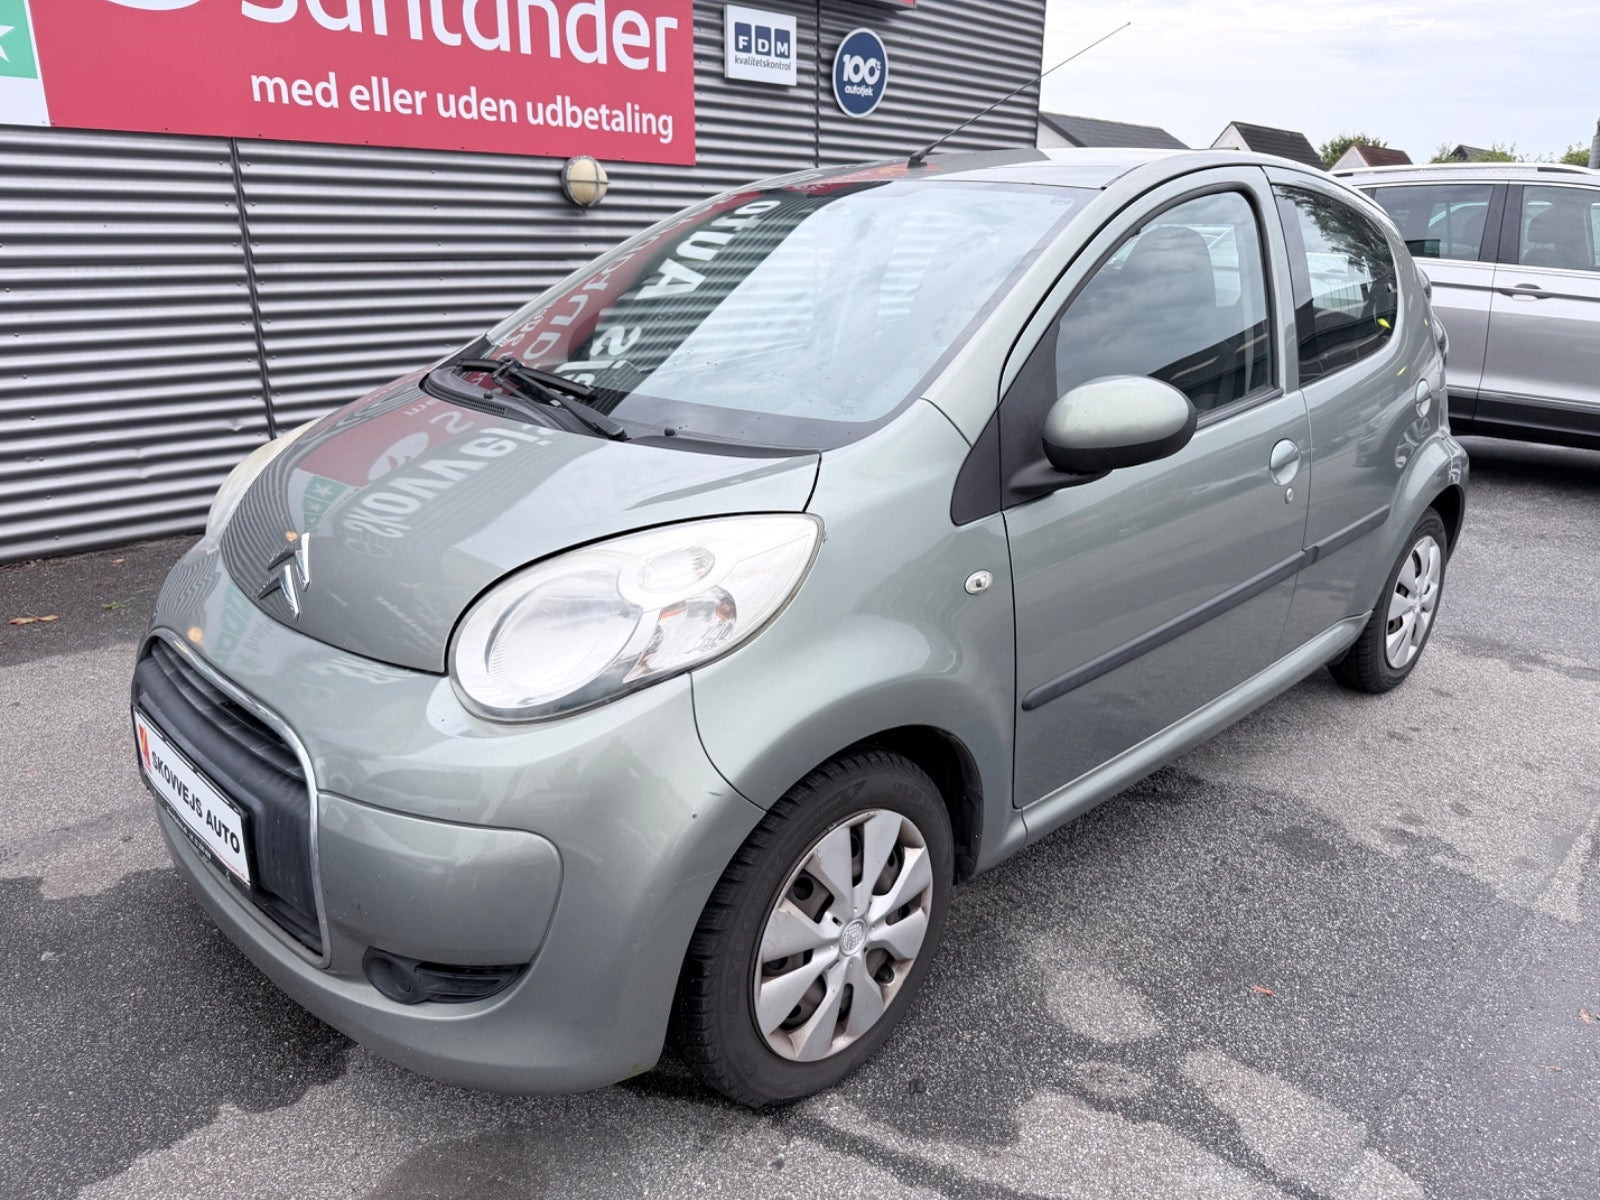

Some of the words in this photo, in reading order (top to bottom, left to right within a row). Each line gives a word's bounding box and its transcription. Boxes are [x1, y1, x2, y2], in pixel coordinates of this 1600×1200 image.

[734, 55, 792, 71] kvalitetskontrol
[737, 35, 790, 56] FDM
[250, 71, 339, 109] med
[349, 75, 427, 116] eller
[436, 86, 518, 123] uden
[526, 95, 674, 144] udbetaling
[152, 752, 203, 818] SKOVVEJS
[206, 812, 240, 854] AUTO
